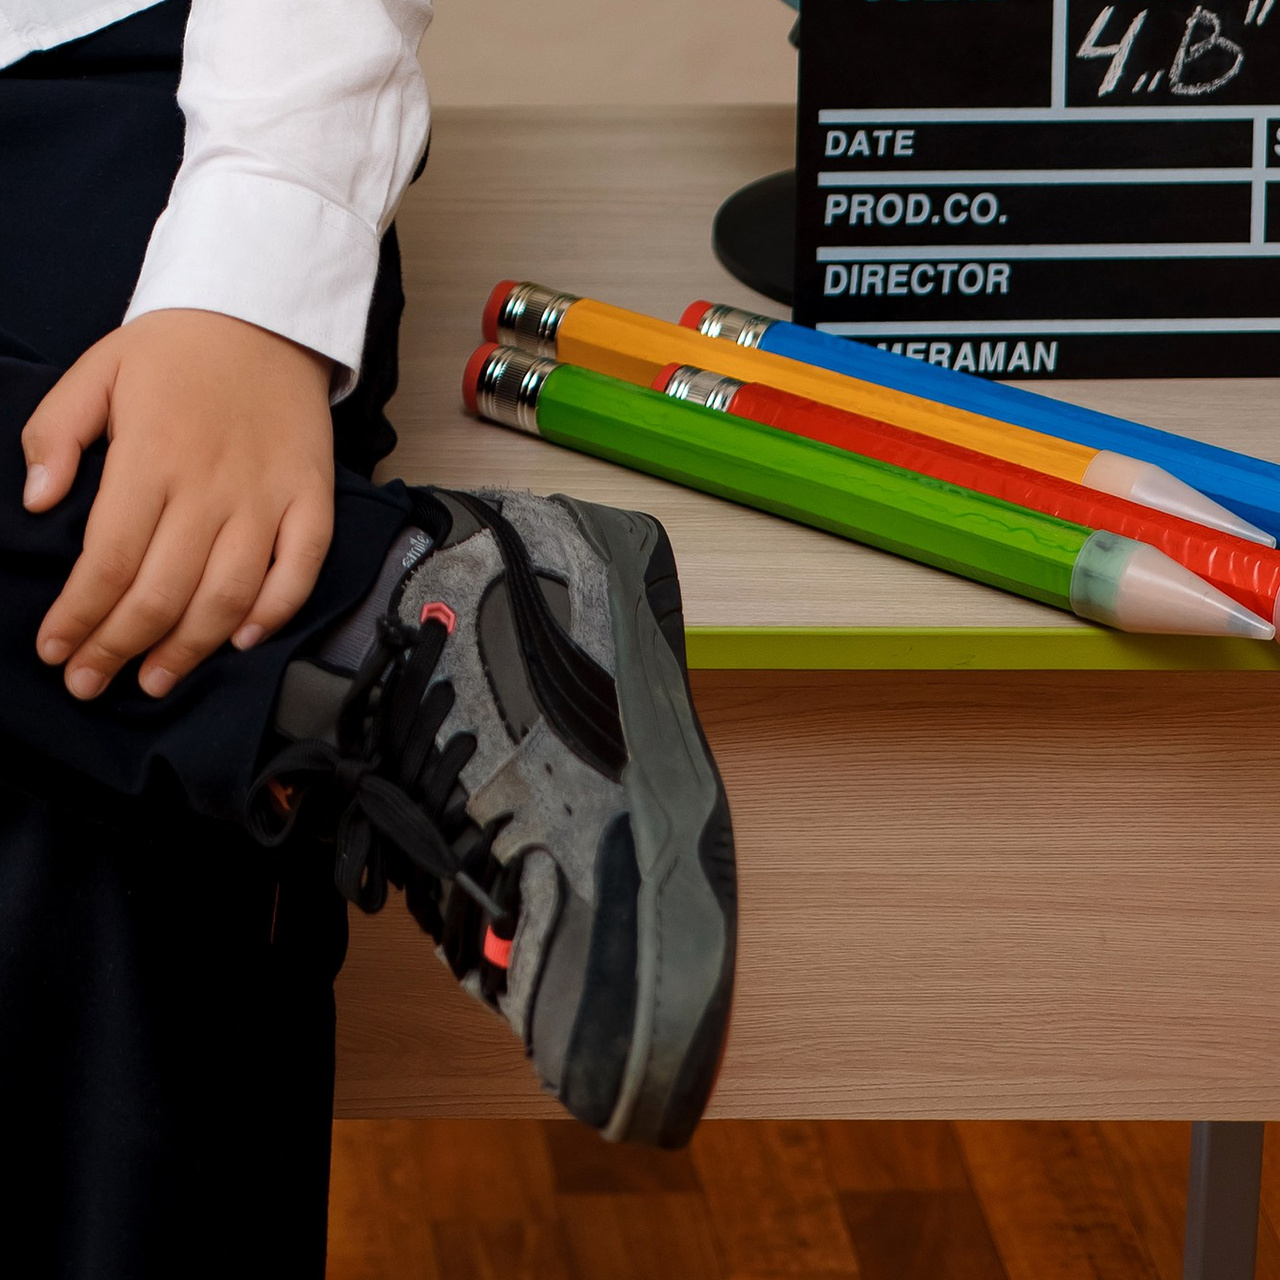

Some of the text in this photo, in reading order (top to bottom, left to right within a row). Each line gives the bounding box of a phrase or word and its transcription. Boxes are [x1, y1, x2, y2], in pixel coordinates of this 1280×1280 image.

[824, 129, 916, 157] DATE
[824, 192, 1008, 226] PROD.CO.
[824, 263, 1011, 297] DIRECTOR
